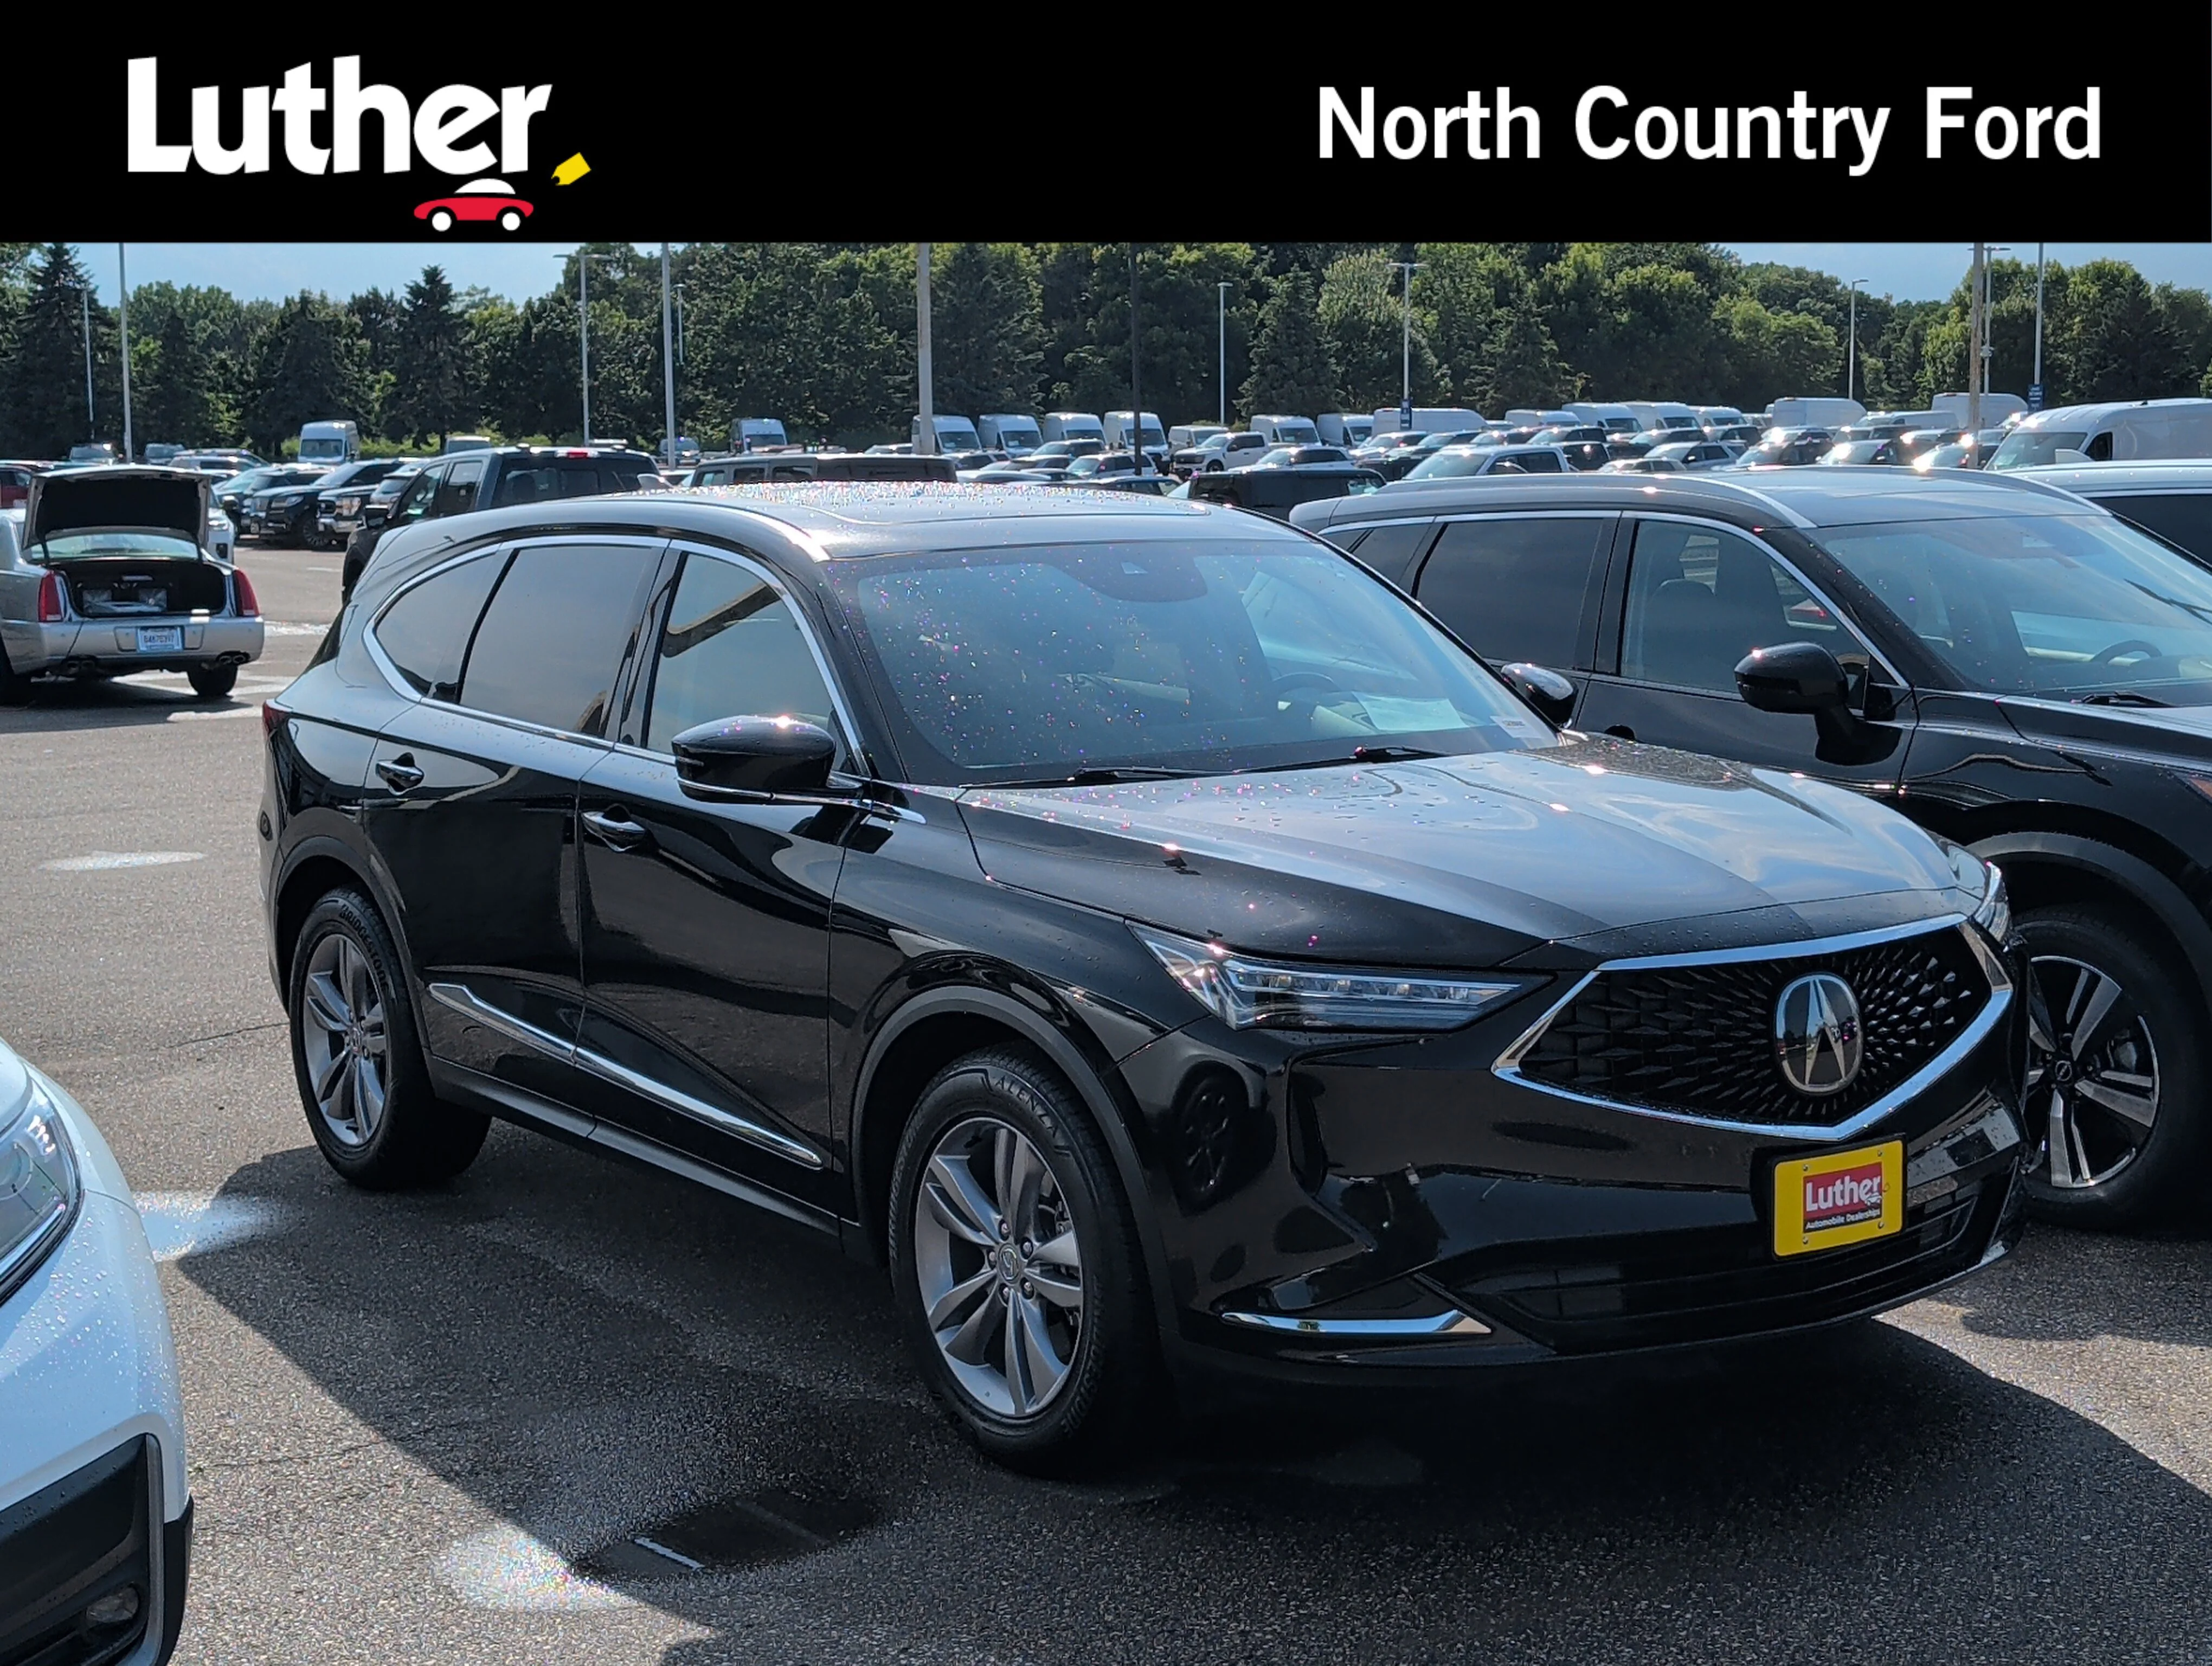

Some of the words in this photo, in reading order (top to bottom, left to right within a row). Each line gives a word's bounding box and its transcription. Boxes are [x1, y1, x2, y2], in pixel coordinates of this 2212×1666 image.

[339, 904, 389, 992] BRIDGESTONE
[994, 1075, 1059, 1138] ALENZA
[1806, 1175, 1881, 1212] Luther
[1805, 1215, 1845, 1230] Automobile
